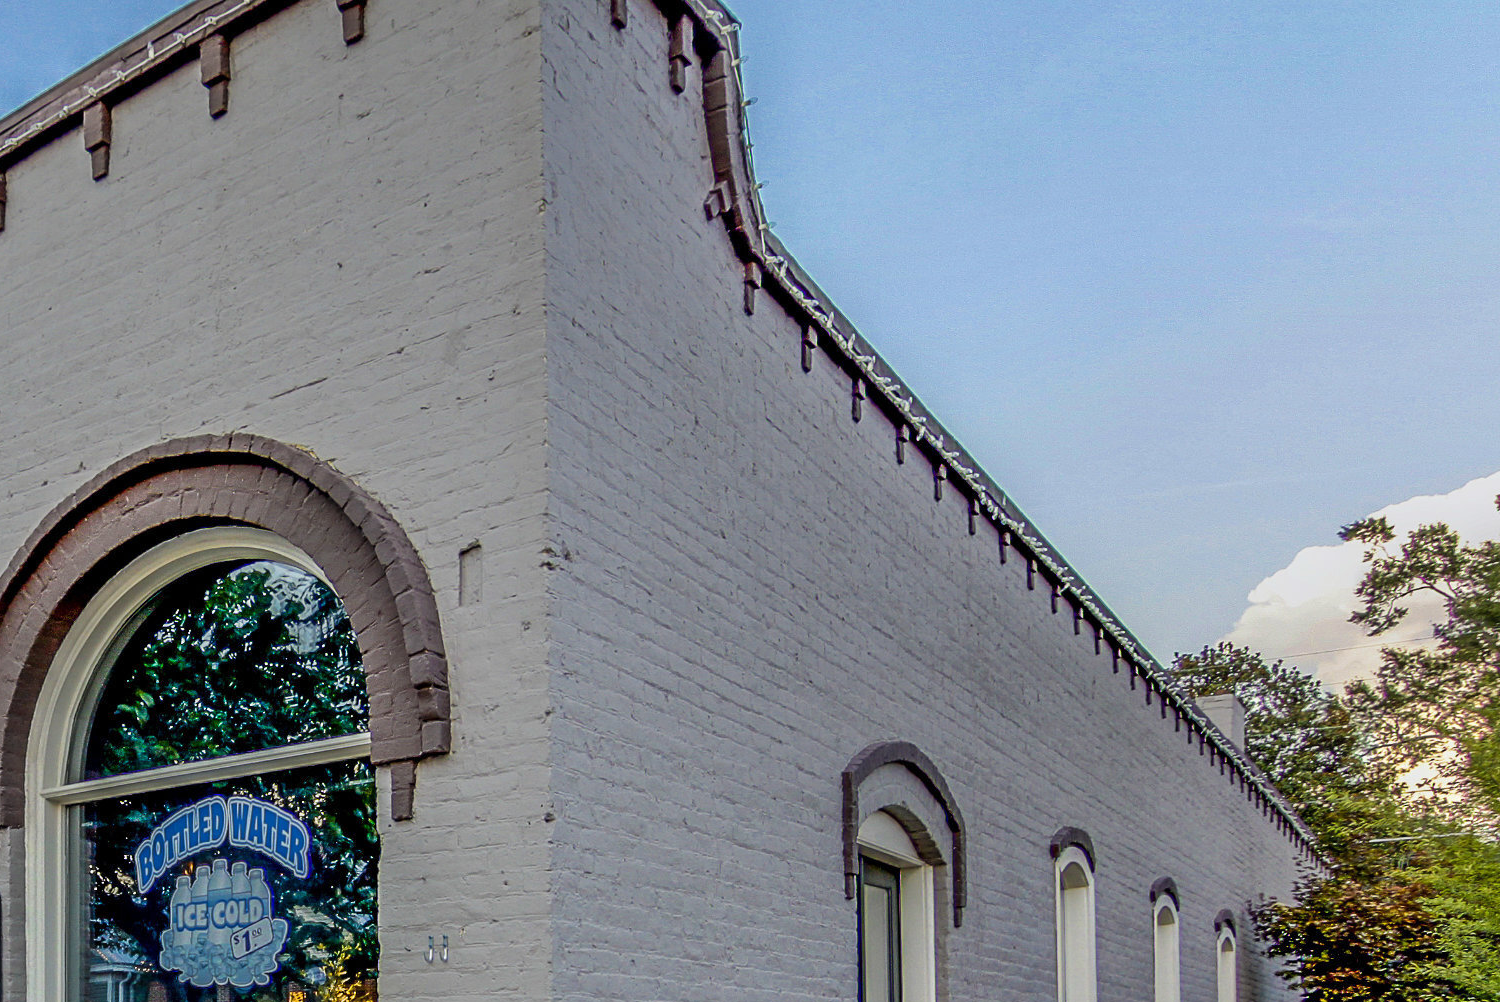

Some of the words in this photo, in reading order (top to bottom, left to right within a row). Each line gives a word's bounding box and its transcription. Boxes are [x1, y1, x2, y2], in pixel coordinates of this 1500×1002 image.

[137, 799, 226, 891] BOTTLED
[231, 801, 307, 875] WATER
[176, 903, 209, 932] ICE
[212, 898, 264, 929] COLD
